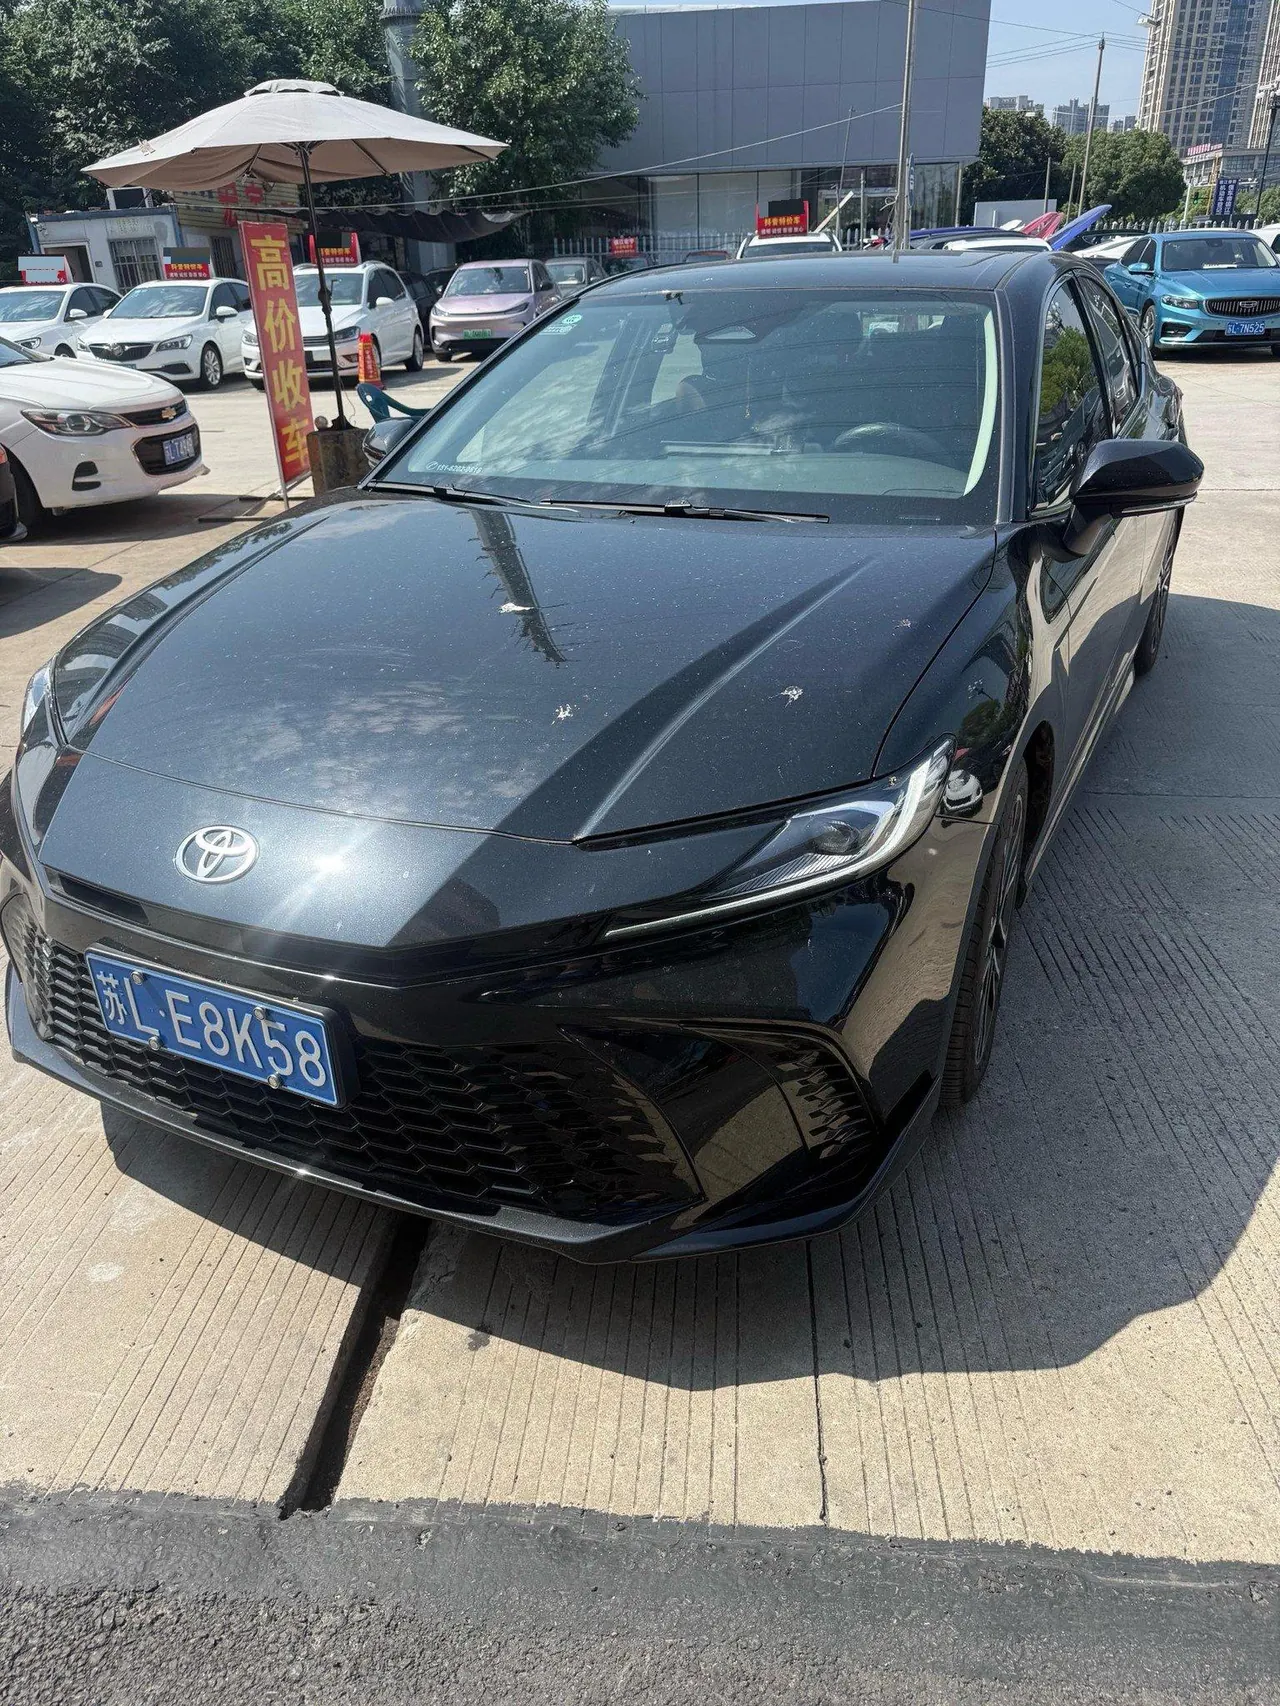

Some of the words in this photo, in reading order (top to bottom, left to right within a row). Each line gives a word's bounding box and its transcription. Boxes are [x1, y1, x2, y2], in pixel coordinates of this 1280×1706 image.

[250, 234, 310, 469] 高价收车
[96, 970, 327, 1088] 苏L·E8K58
